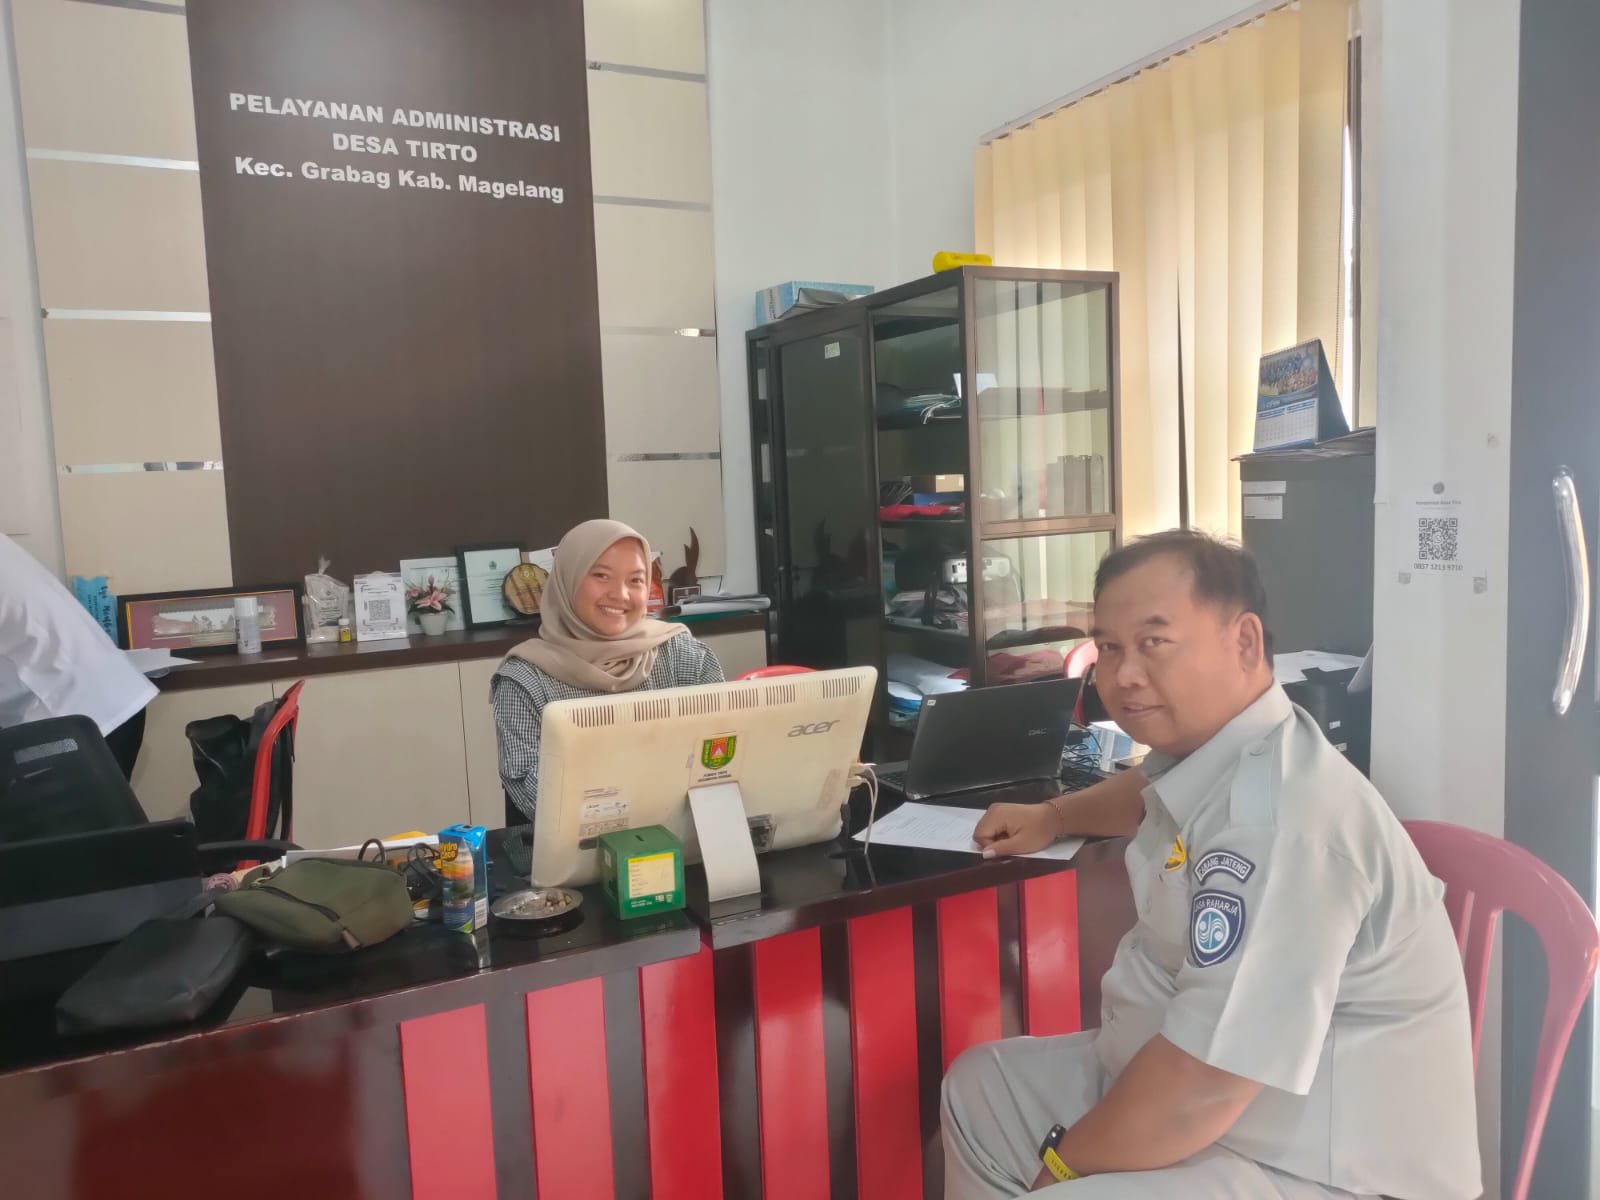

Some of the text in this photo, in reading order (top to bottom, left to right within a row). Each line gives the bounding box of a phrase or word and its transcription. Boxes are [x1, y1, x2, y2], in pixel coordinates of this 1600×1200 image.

[229, 92, 561, 142] PELAYANAN ADMINISTRASI
[332, 132, 478, 163] DESA TIRTO
[235, 156, 564, 204] Kec. Grabag Kab. Magelang
[787, 720, 841, 738] acer
[1220, 856, 1247, 875] JATENG
[1206, 898, 1239, 916] RAHARJA
